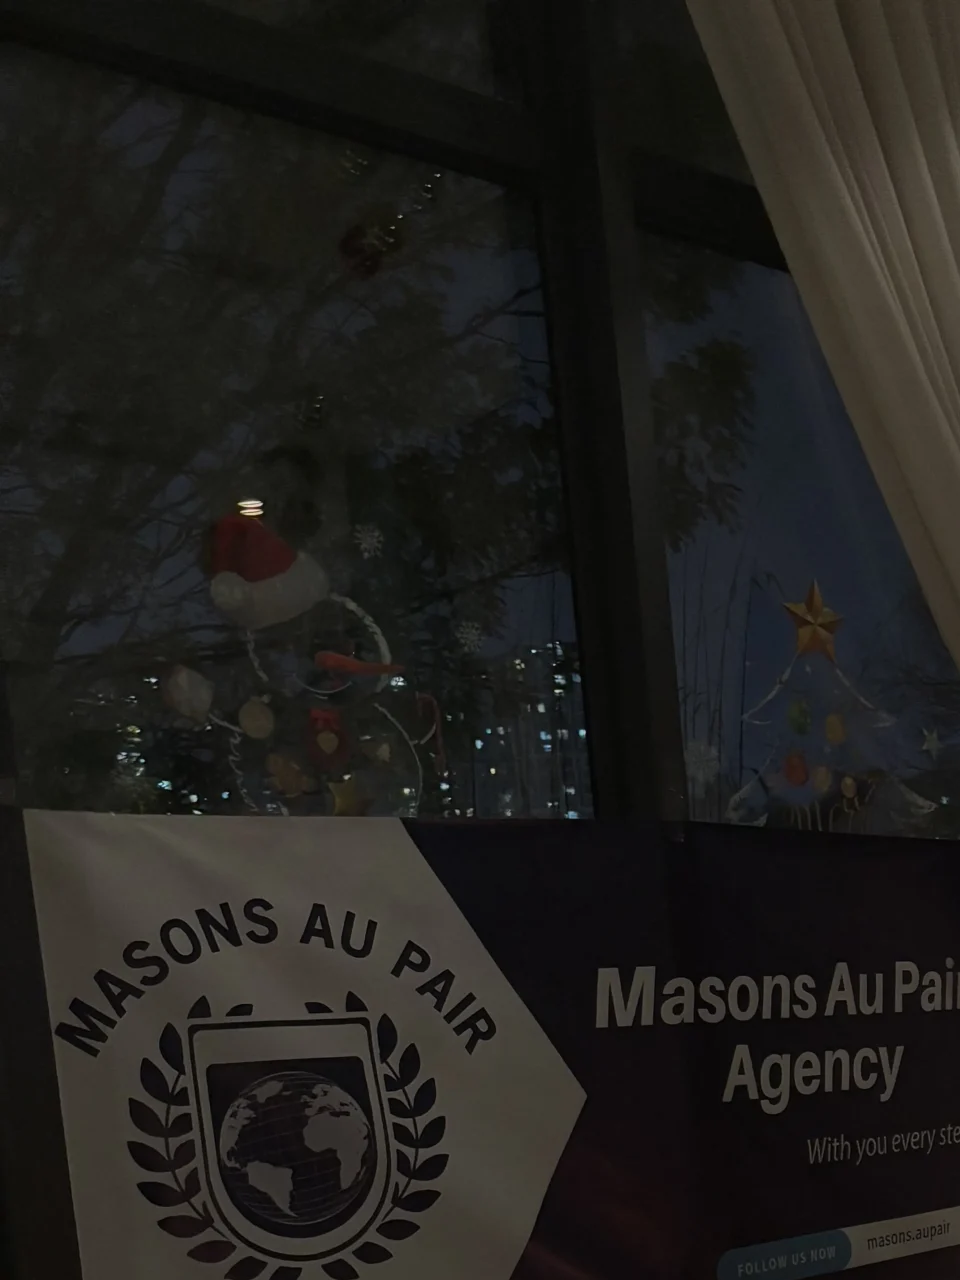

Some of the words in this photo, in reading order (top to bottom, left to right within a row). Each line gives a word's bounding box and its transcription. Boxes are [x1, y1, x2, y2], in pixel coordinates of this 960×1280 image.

[54, 898, 279, 1057] MASONS
[299, 902, 378, 958] AU
[391, 940, 498, 1054] PAIR
[595, 966, 817, 1028] Masons
[824, 961, 884, 1017] Au
[722, 1044, 905, 1115] Agency
[807, 1134, 852, 1164] With
[856, 1134, 887, 1165] you
[892, 1127, 935, 1156] every
[866, 1219, 951, 1251] masons.aupair
[737, 1255, 787, 1278] FOLLOW
[791, 1251, 807, 1267] US
[810, 1245, 837, 1264] NOW
